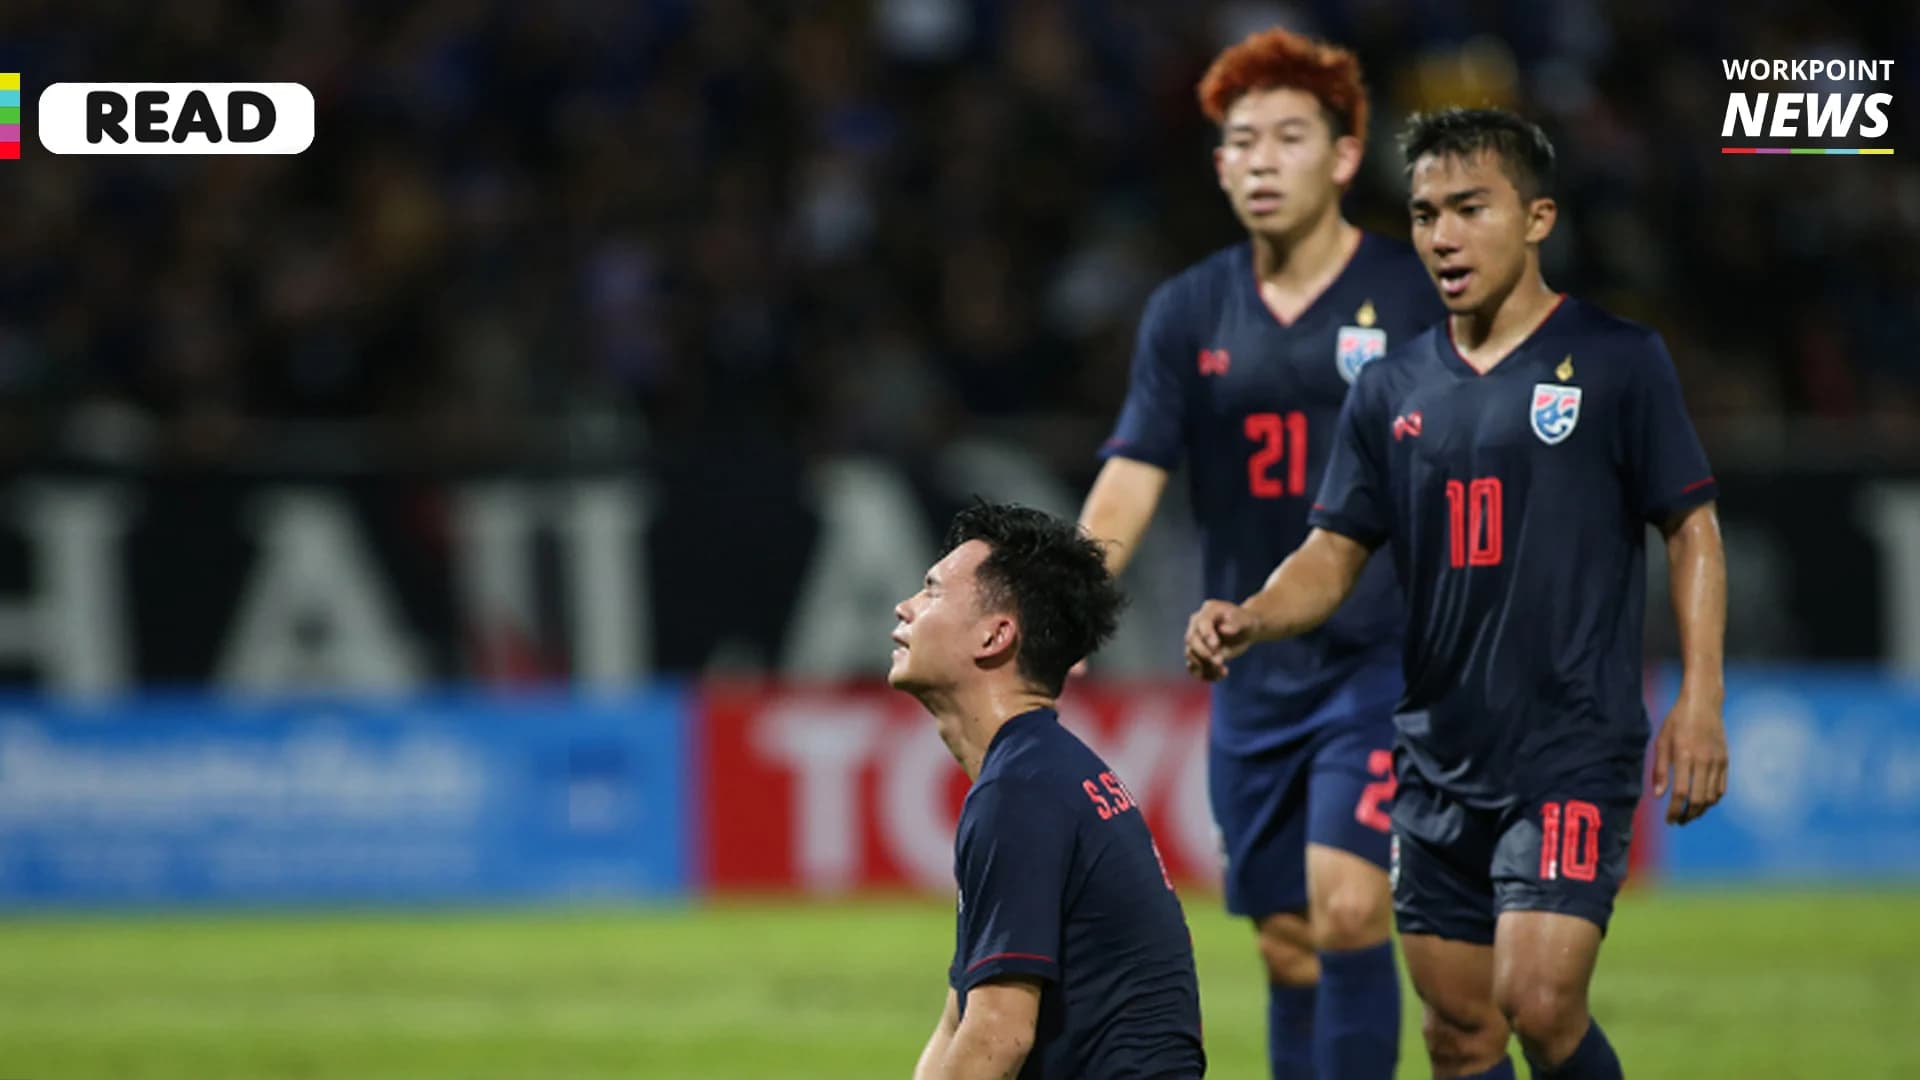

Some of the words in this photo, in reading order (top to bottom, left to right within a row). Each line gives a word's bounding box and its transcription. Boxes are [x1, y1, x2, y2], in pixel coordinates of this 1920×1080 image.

[1244, 412, 1308, 498] 21
[1446, 477, 1503, 568] 10
[1539, 799, 1603, 882] 10
